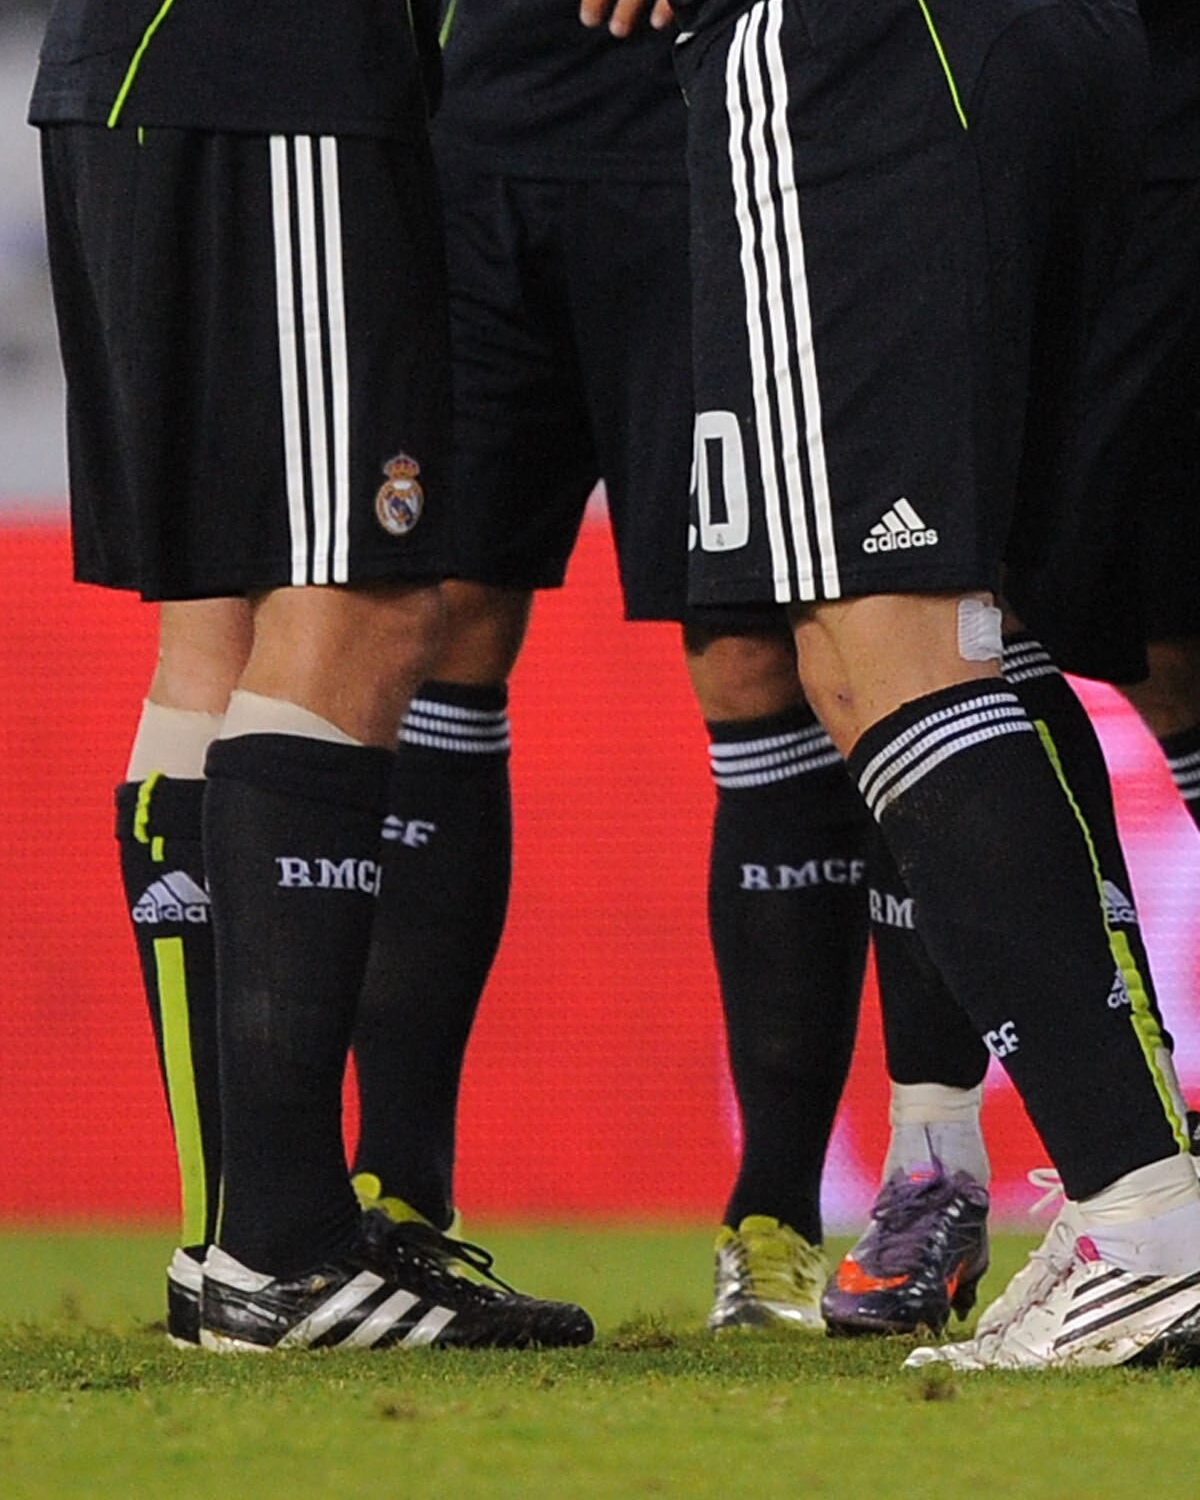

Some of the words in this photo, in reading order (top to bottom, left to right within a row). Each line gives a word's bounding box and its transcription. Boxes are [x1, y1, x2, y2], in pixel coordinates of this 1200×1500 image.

[862, 528, 939, 554] adidas
[275, 856, 382, 897] RMC
[868, 887, 916, 930] RM
[981, 1020, 1020, 1058] CF
